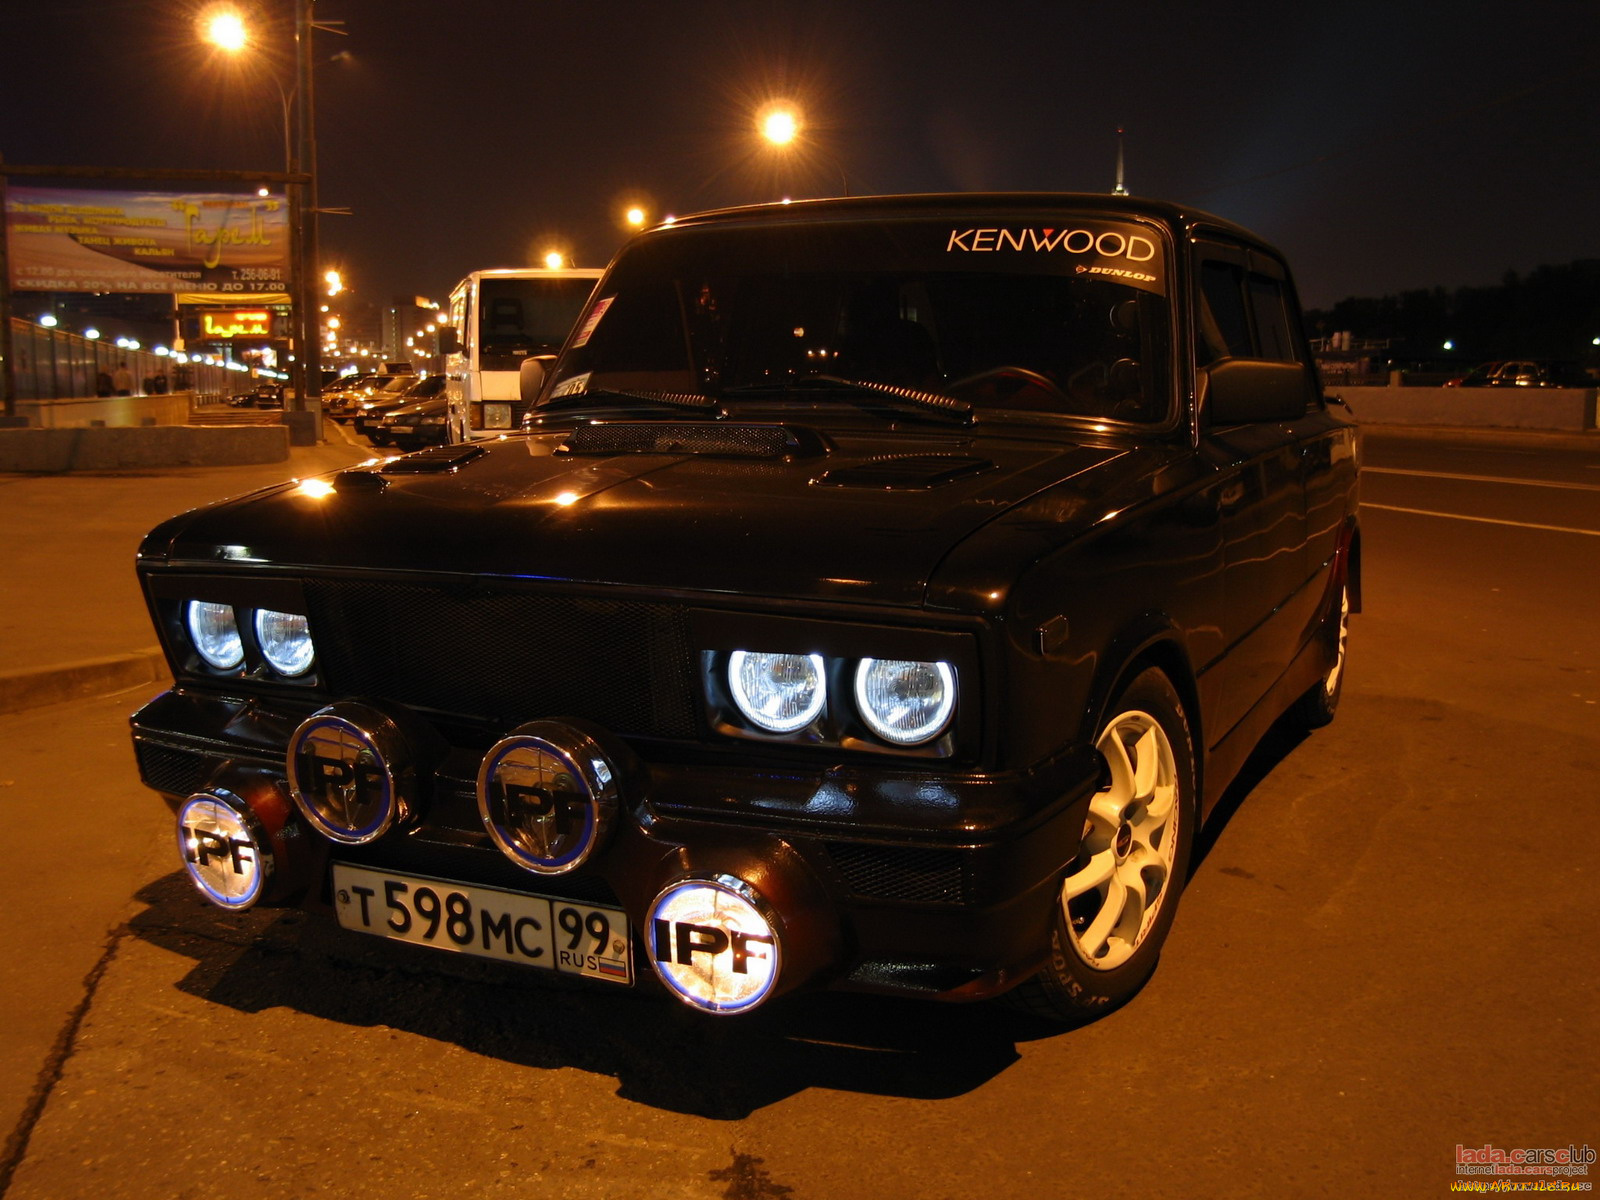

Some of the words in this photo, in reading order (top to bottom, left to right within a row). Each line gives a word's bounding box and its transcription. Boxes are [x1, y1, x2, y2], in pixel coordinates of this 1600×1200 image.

[78, 236, 112, 246] ТАНЕЦ
[113, 237, 157, 247] ЖИВОТА
[134, 247, 175, 257] КАЛЬЯН
[947, 228, 1155, 262] KENWOOD
[17, 279, 78, 290] СКИДКА
[83, 280, 112, 290] 20%
[117, 281, 138, 290] НА
[142, 281, 169, 291] ВСЕ
[173, 282, 218, 292] МЕНЮ
[221, 282, 244, 292] ДО
[249, 282, 286, 292] 17.00
[1089, 265, 1157, 283] DUNLOP
[299, 752, 389, 805] IPF
[488, 781, 592, 834] IPF
[181, 825, 256, 875] IPF
[557, 907, 610, 955] 99
[654, 917, 775, 974] IPF
[559, 950, 598, 970] RUS
